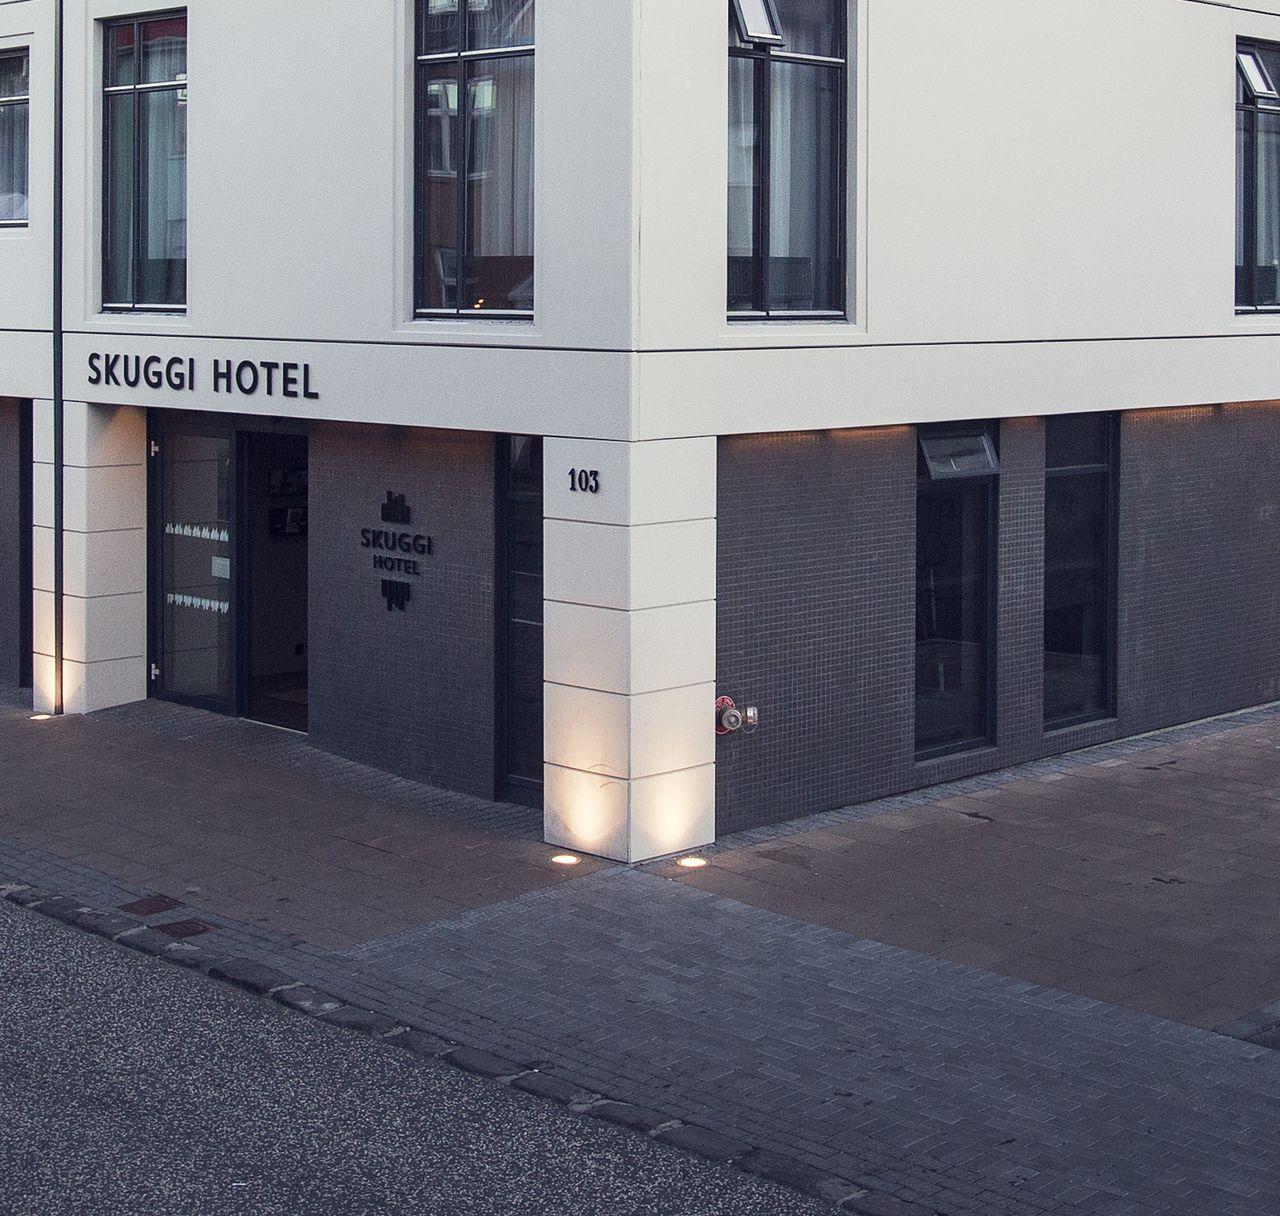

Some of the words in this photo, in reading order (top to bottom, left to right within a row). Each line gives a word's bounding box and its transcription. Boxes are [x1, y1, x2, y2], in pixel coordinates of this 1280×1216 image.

[87, 352, 195, 390] SKUGGI
[213, 359, 319, 400] HOTEL
[568, 468, 600, 493] 103
[360, 528, 433, 555] SKUGGI
[373, 554, 420, 575] HOTEL
